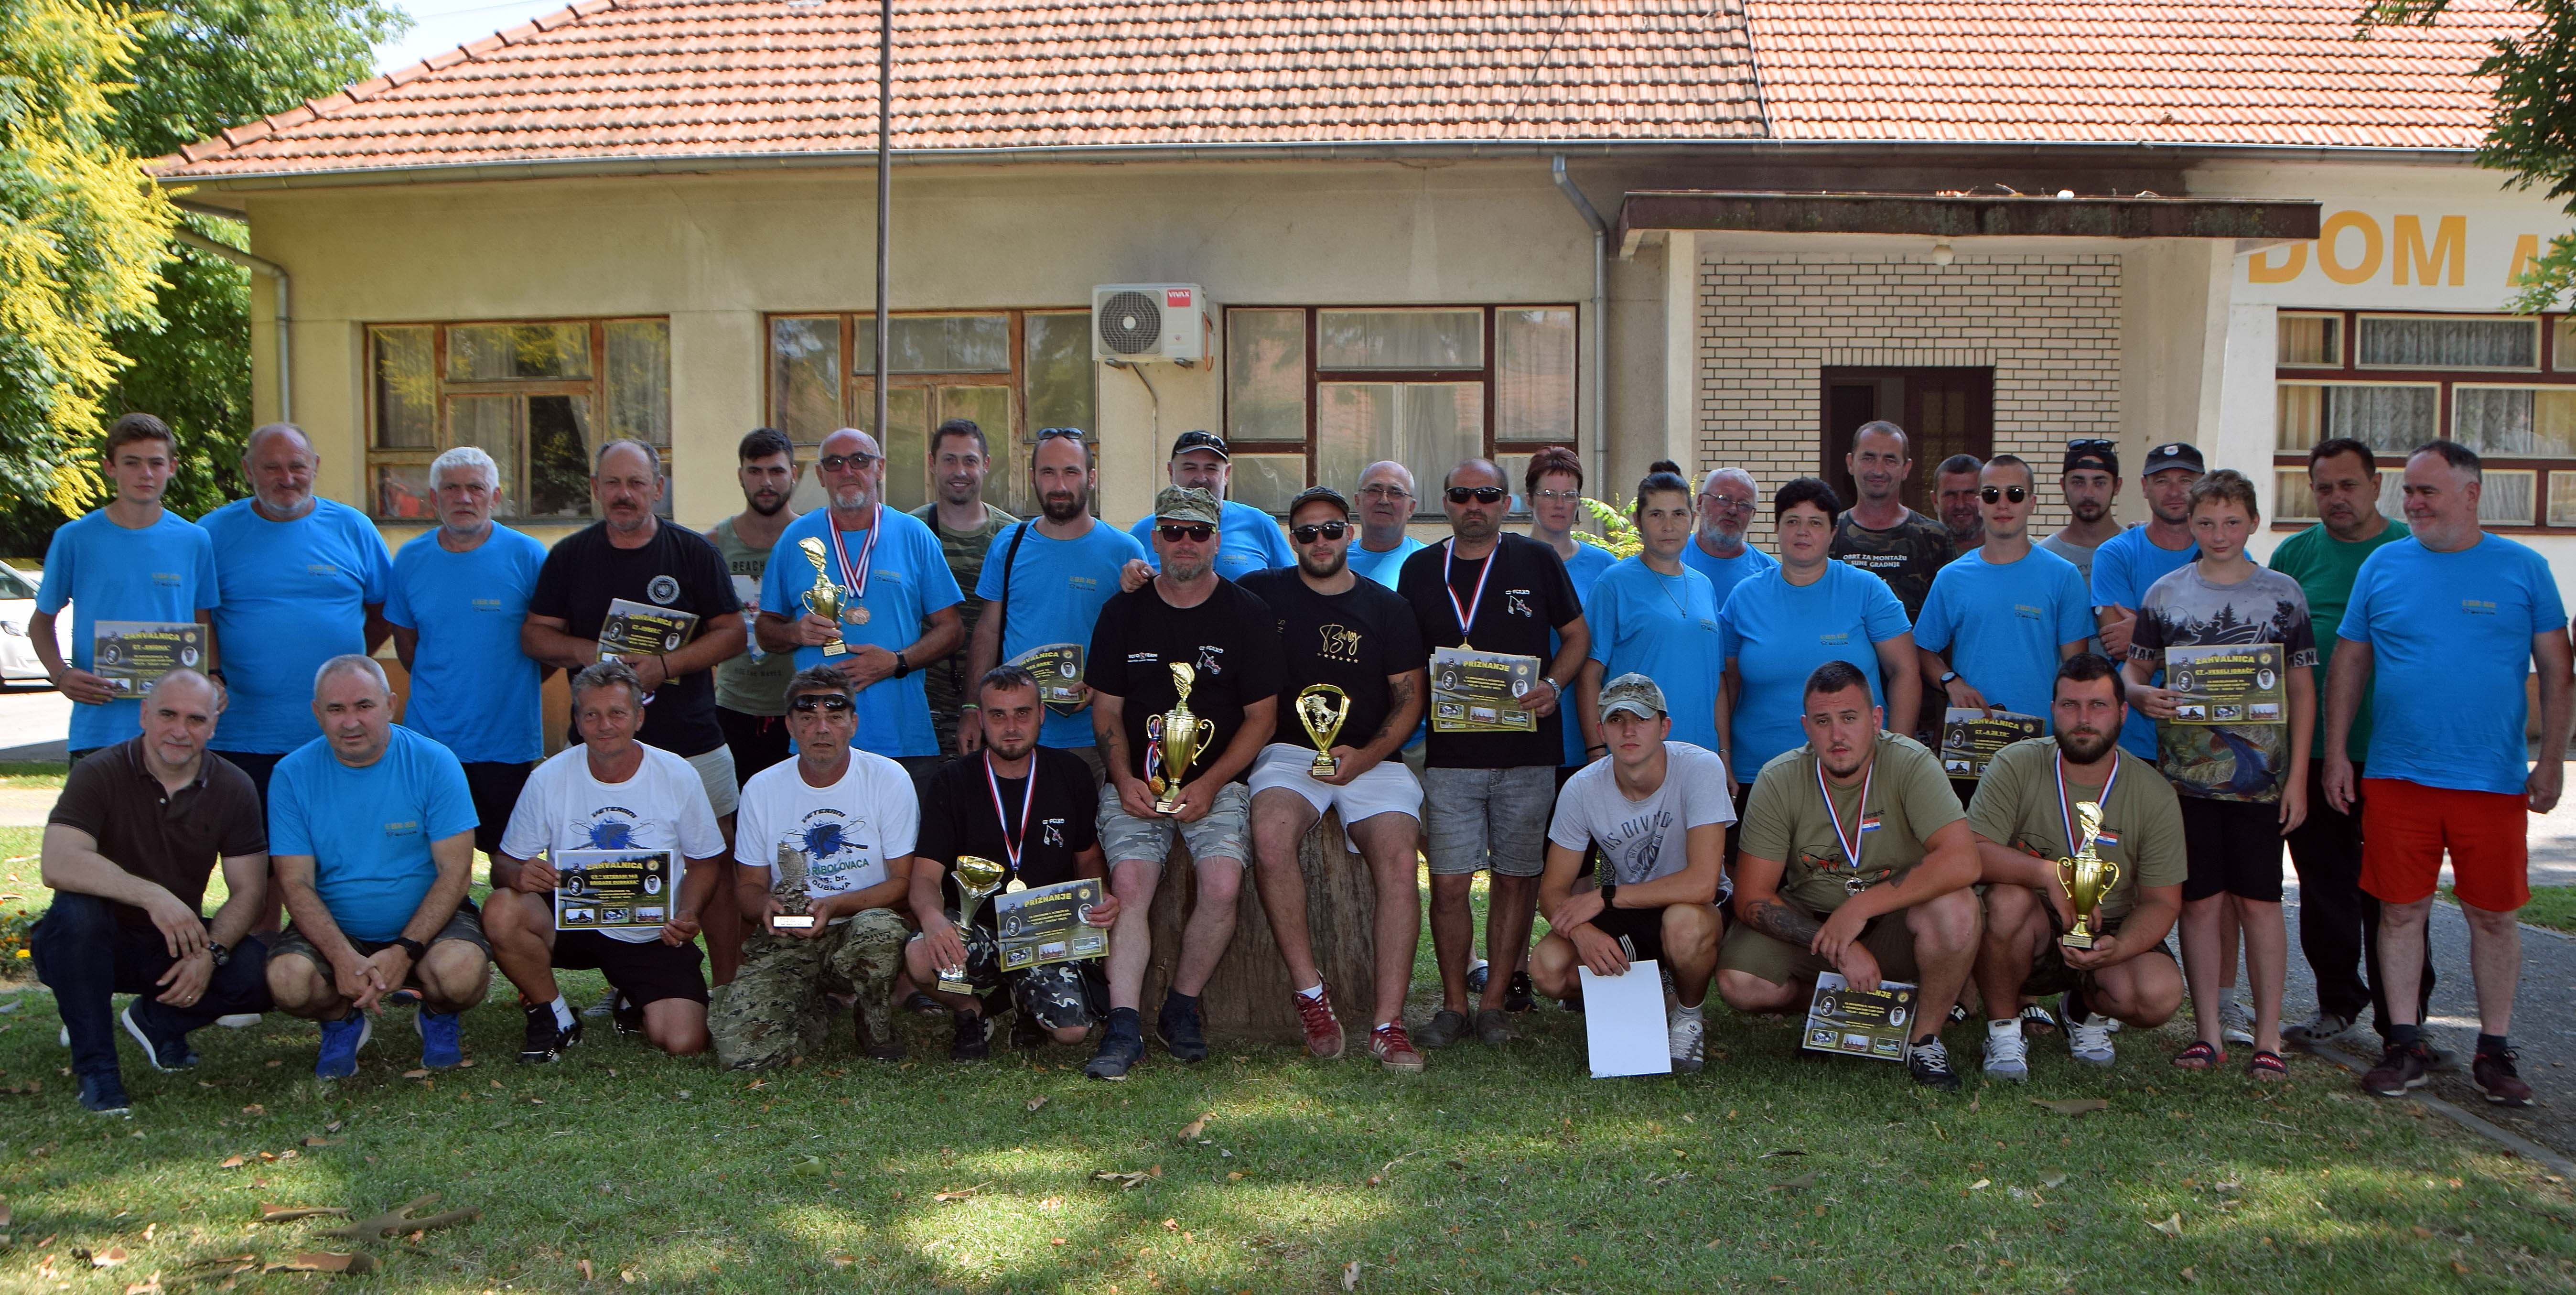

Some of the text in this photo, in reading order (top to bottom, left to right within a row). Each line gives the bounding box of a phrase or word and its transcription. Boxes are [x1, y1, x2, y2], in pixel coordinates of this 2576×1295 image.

[2249, 209, 2467, 286] DOM
[1168, 291, 1190, 299] VIVAX
[732, 561, 765, 572] BEACH
[1463, 660, 1510, 672] PRIZNANJE
[2195, 655, 2255, 665] ZAHVALNICA
[1968, 718, 2020, 730] ZAHVALNICA
[591, 807, 638, 818] VETERANI
[801, 809, 846, 823] VETERANI
[586, 862, 644, 870] ZAHVALNICA
[812, 858, 870, 875] RIBOLOVACA
[1024, 893, 1072, 907] PRIZNANJE
